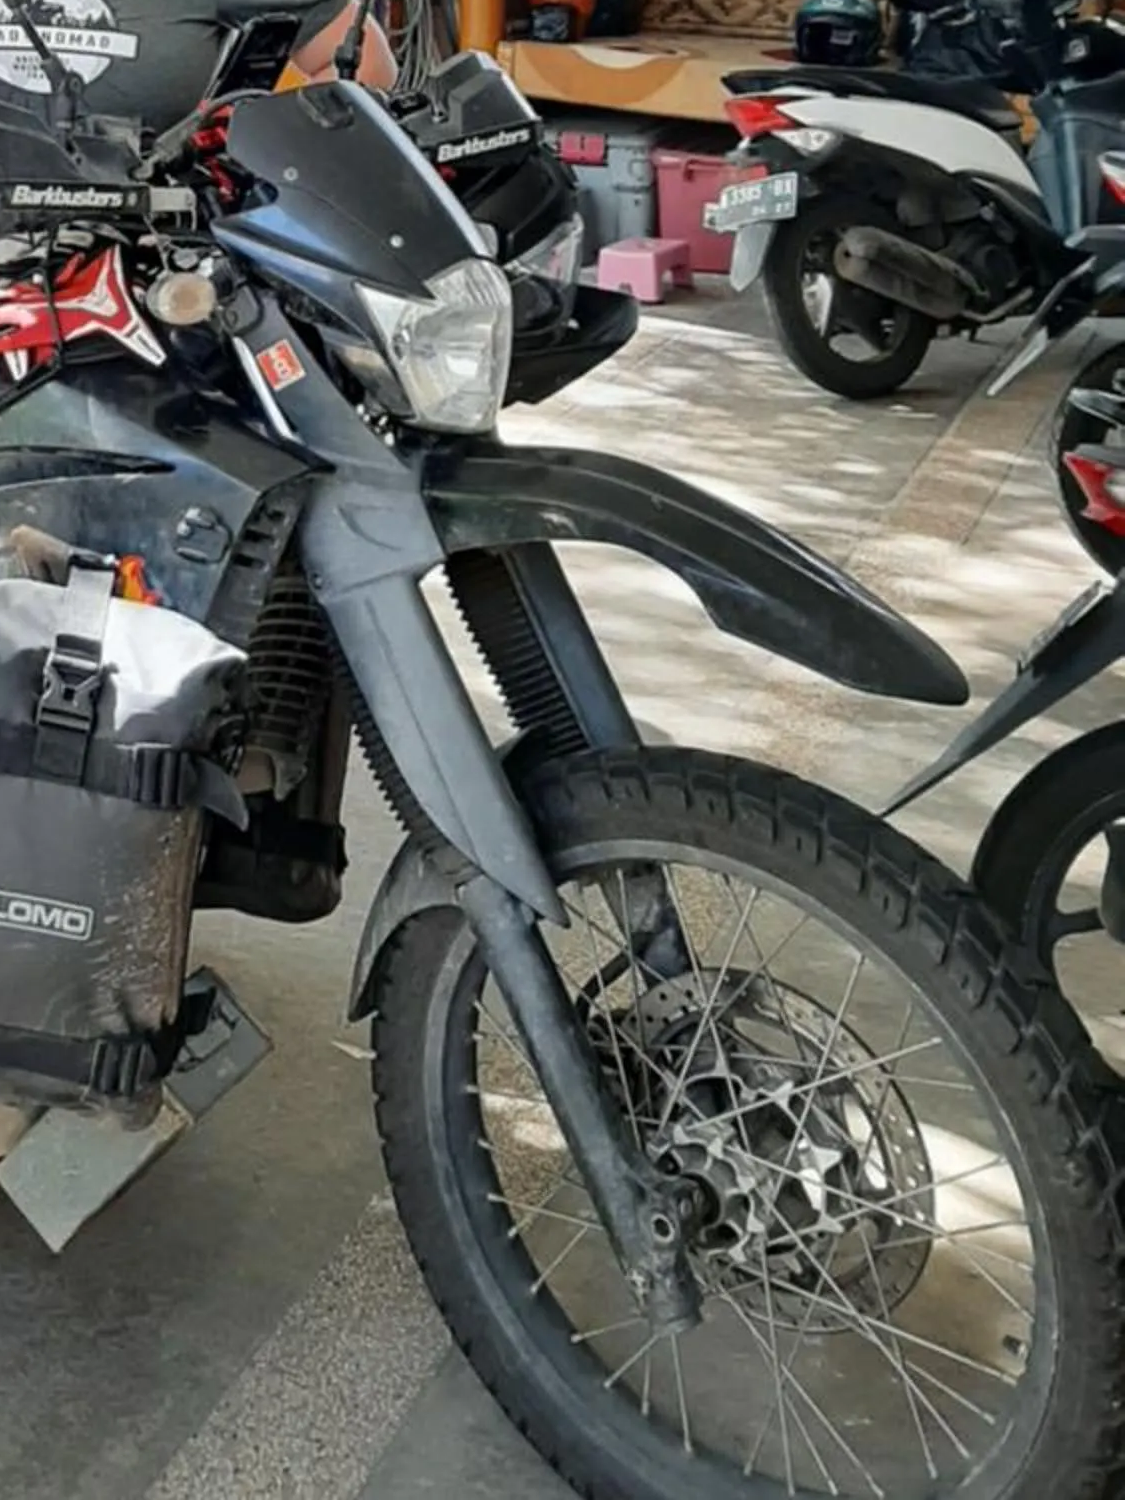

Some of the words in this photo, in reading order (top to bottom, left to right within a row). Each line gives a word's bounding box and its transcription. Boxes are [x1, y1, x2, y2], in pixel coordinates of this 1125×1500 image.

[41, 31, 111, 49] NOMAD
[437, 129, 530, 163] Barkbusters
[10, 184, 124, 208] Barkbusters
